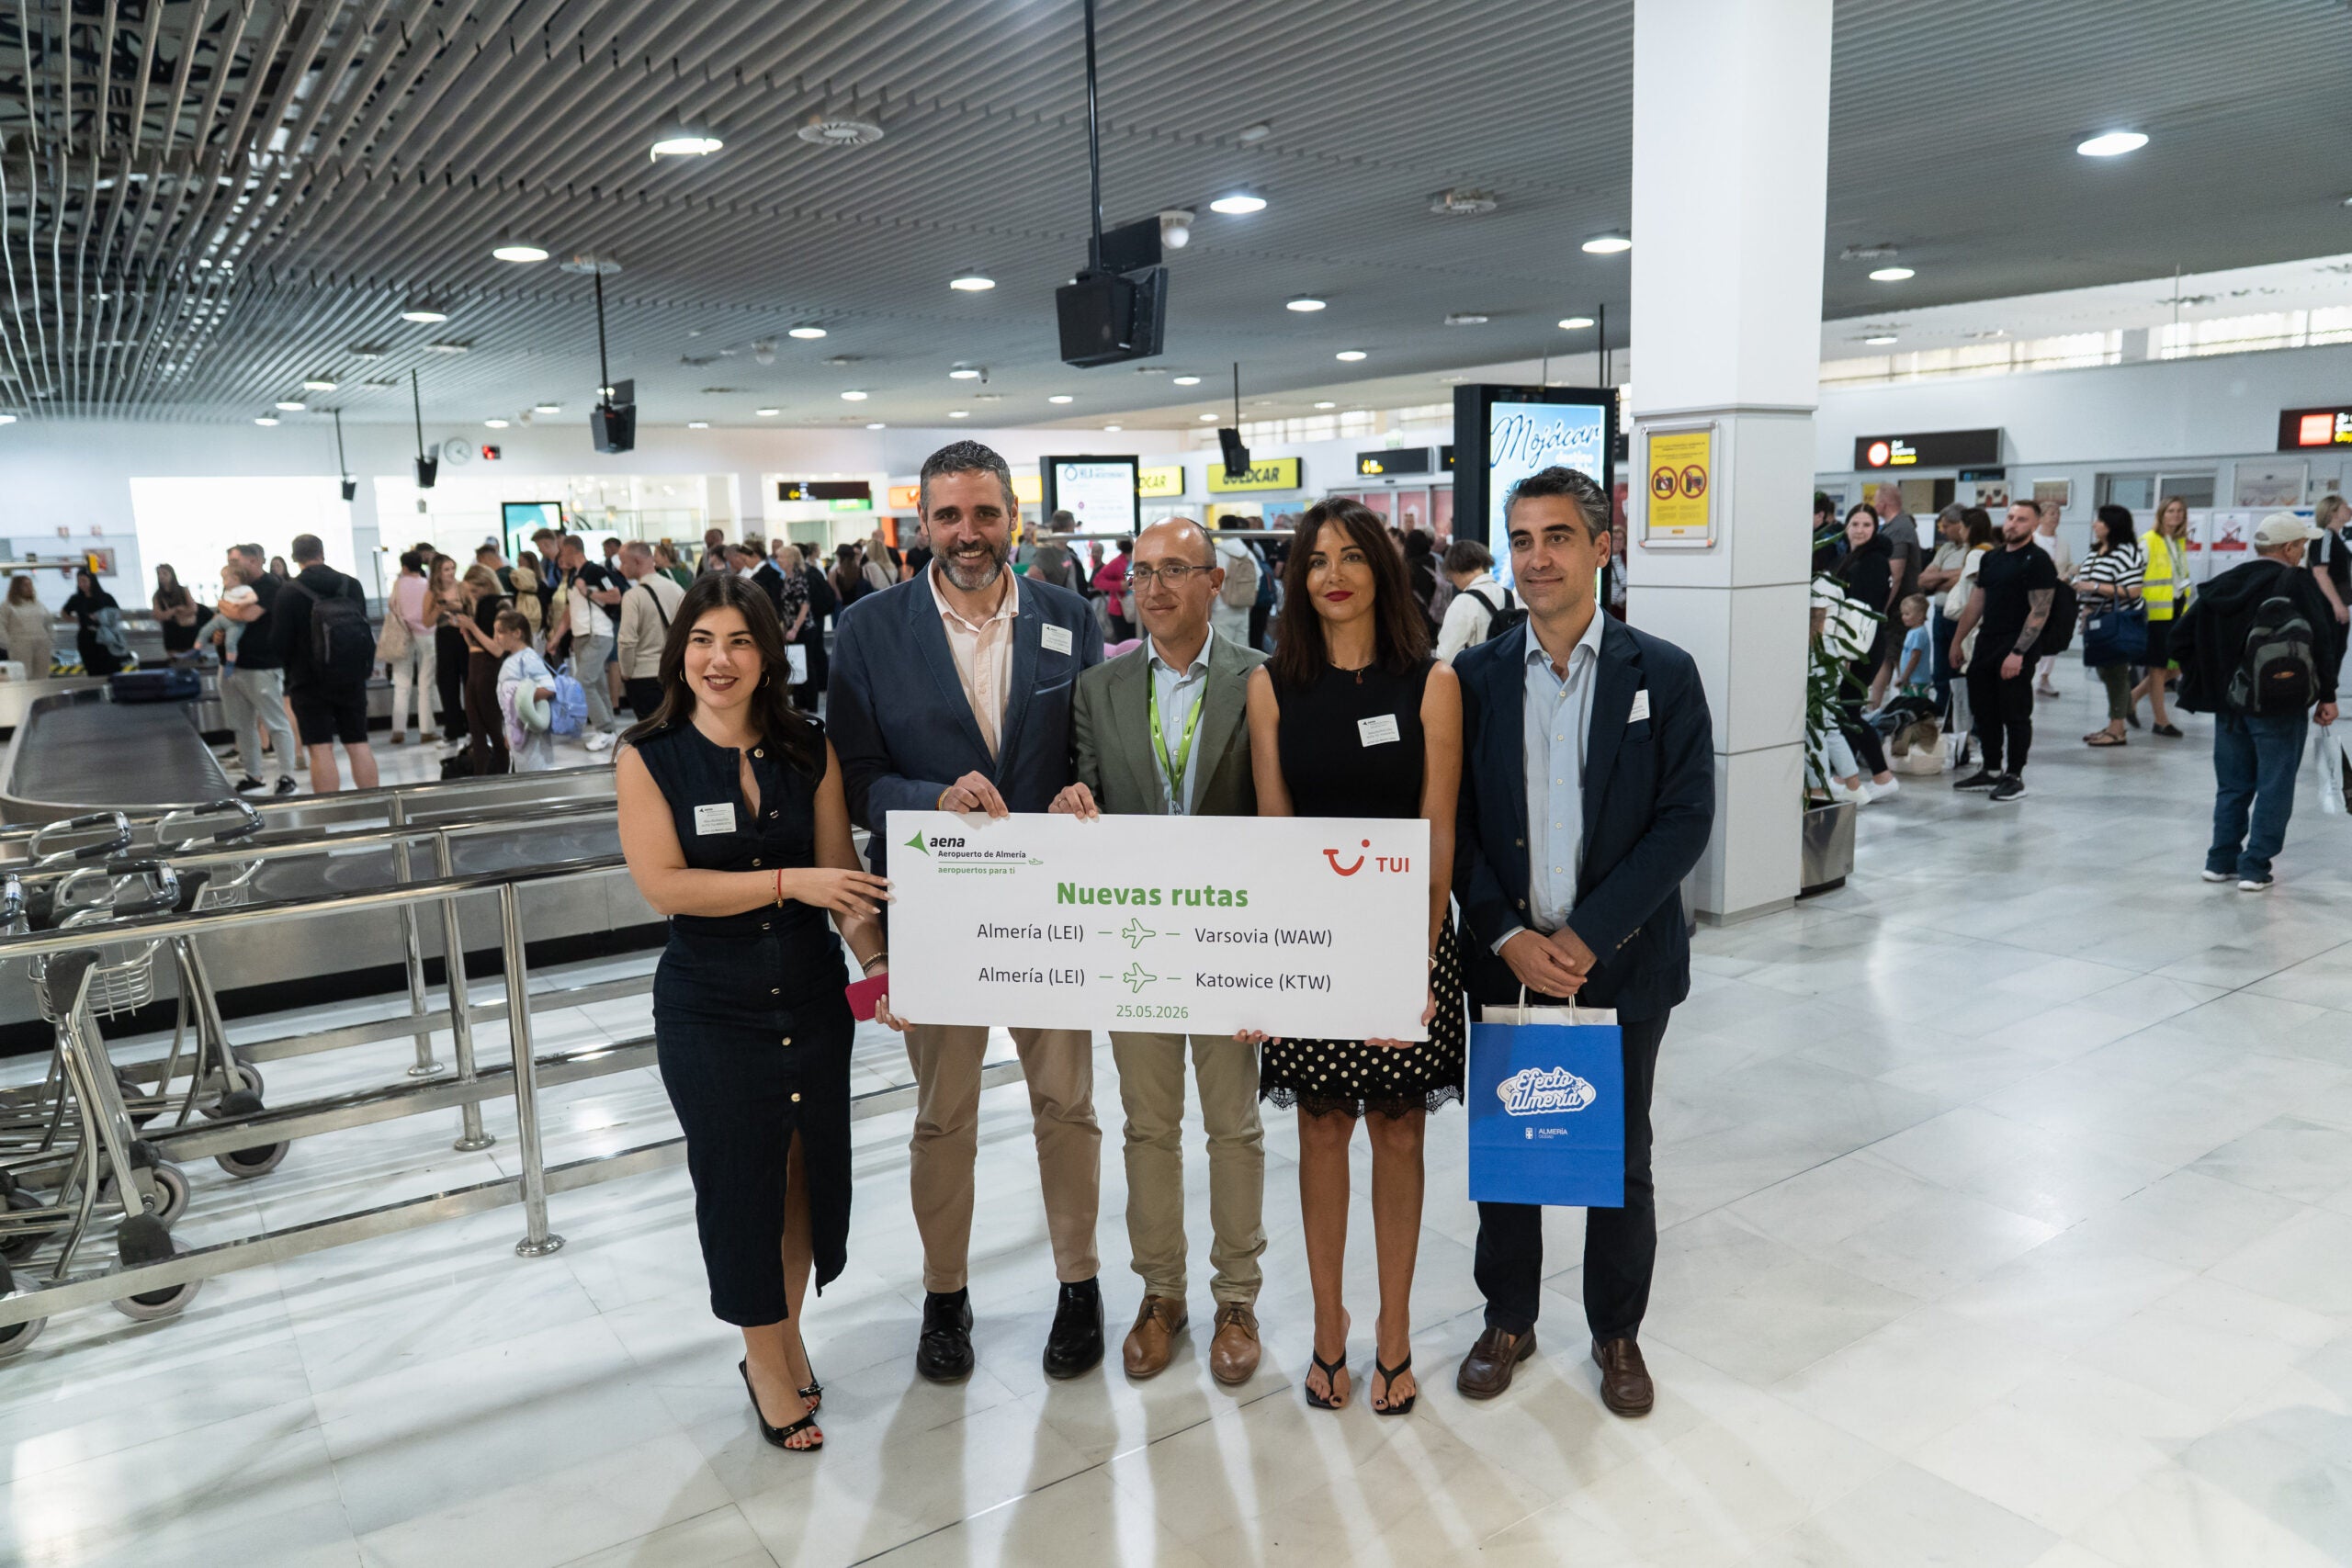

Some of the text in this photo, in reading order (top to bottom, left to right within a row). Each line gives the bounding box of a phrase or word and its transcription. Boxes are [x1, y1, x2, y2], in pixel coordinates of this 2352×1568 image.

[1489, 413, 1600, 469] Mojácar
[929, 837, 966, 848] aena
[937, 850, 1026, 859] Aeropuerto de Almería
[937, 866, 988, 874] aeropuertos
[1009, 866, 1015, 874] ti
[1374, 856, 1409, 874] TUI
[1057, 882, 1249, 908] Nuevas rutas
[977, 922, 1332, 948] Almería (LEI) Varsovia (WAW)
[978, 966, 1331, 993] Almería (LEI) Katowice (KTW)
[1116, 1004, 1189, 1019] 25.05.2026
[1516, 1069, 1574, 1092] Efecto
[1538, 1127, 1568, 1135] ALMERÍA
